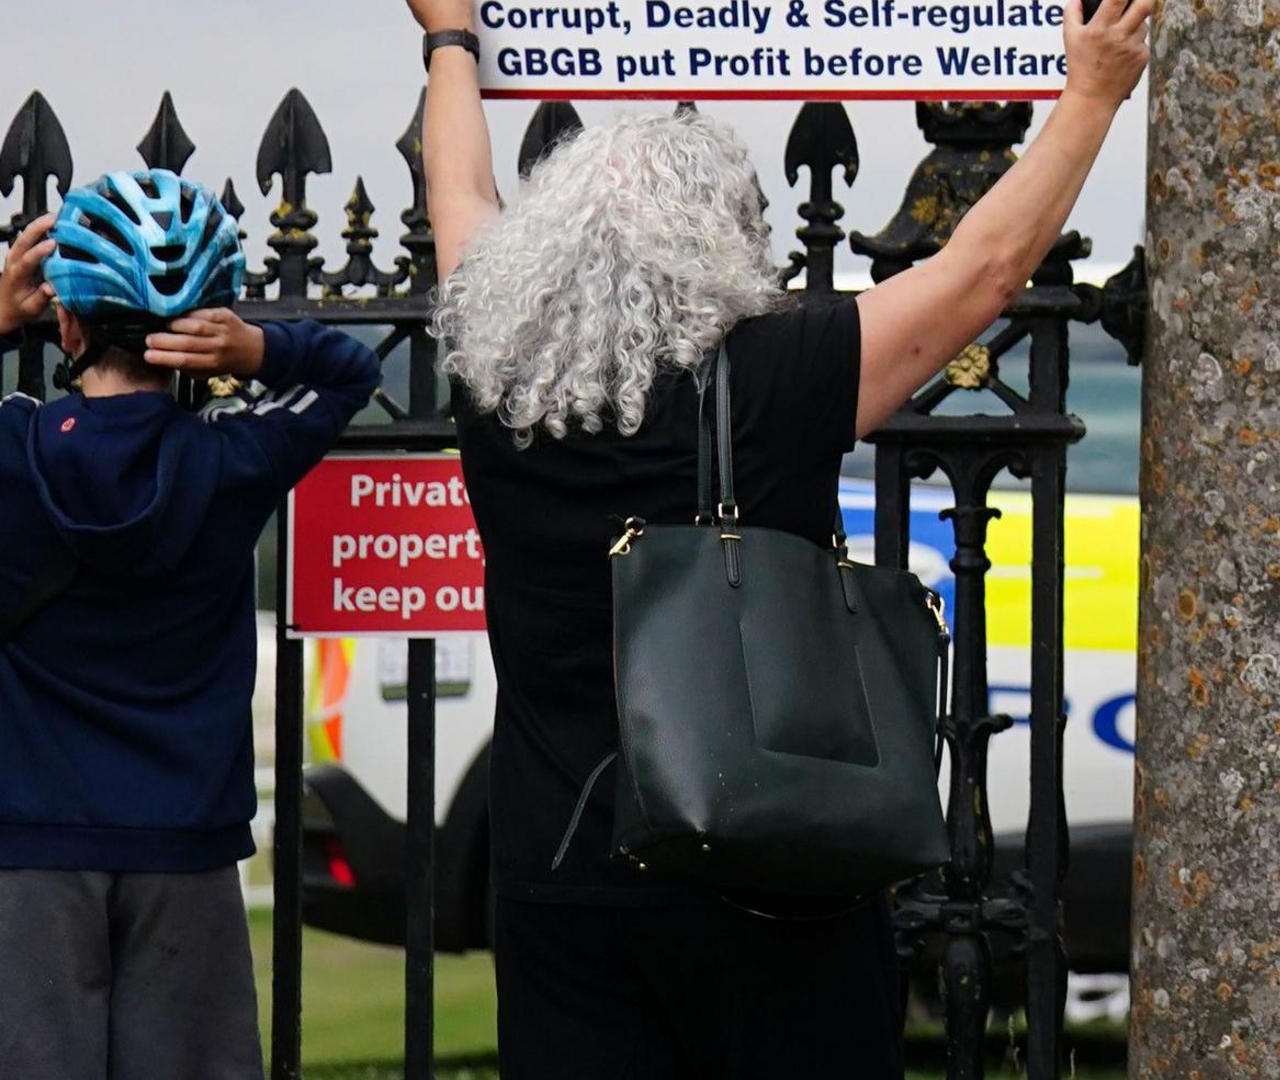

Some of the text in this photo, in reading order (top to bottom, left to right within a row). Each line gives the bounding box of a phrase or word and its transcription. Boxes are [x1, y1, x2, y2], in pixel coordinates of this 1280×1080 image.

[480, 1, 631, 35] Corrupt,
[646, 0, 771, 32] Deadly
[786, 0, 810, 27] &
[497, 46, 1067, 82] GBGB put Profit before Welfare
[333, 528, 486, 568] propert
[333, 577, 485, 620] keep ou
